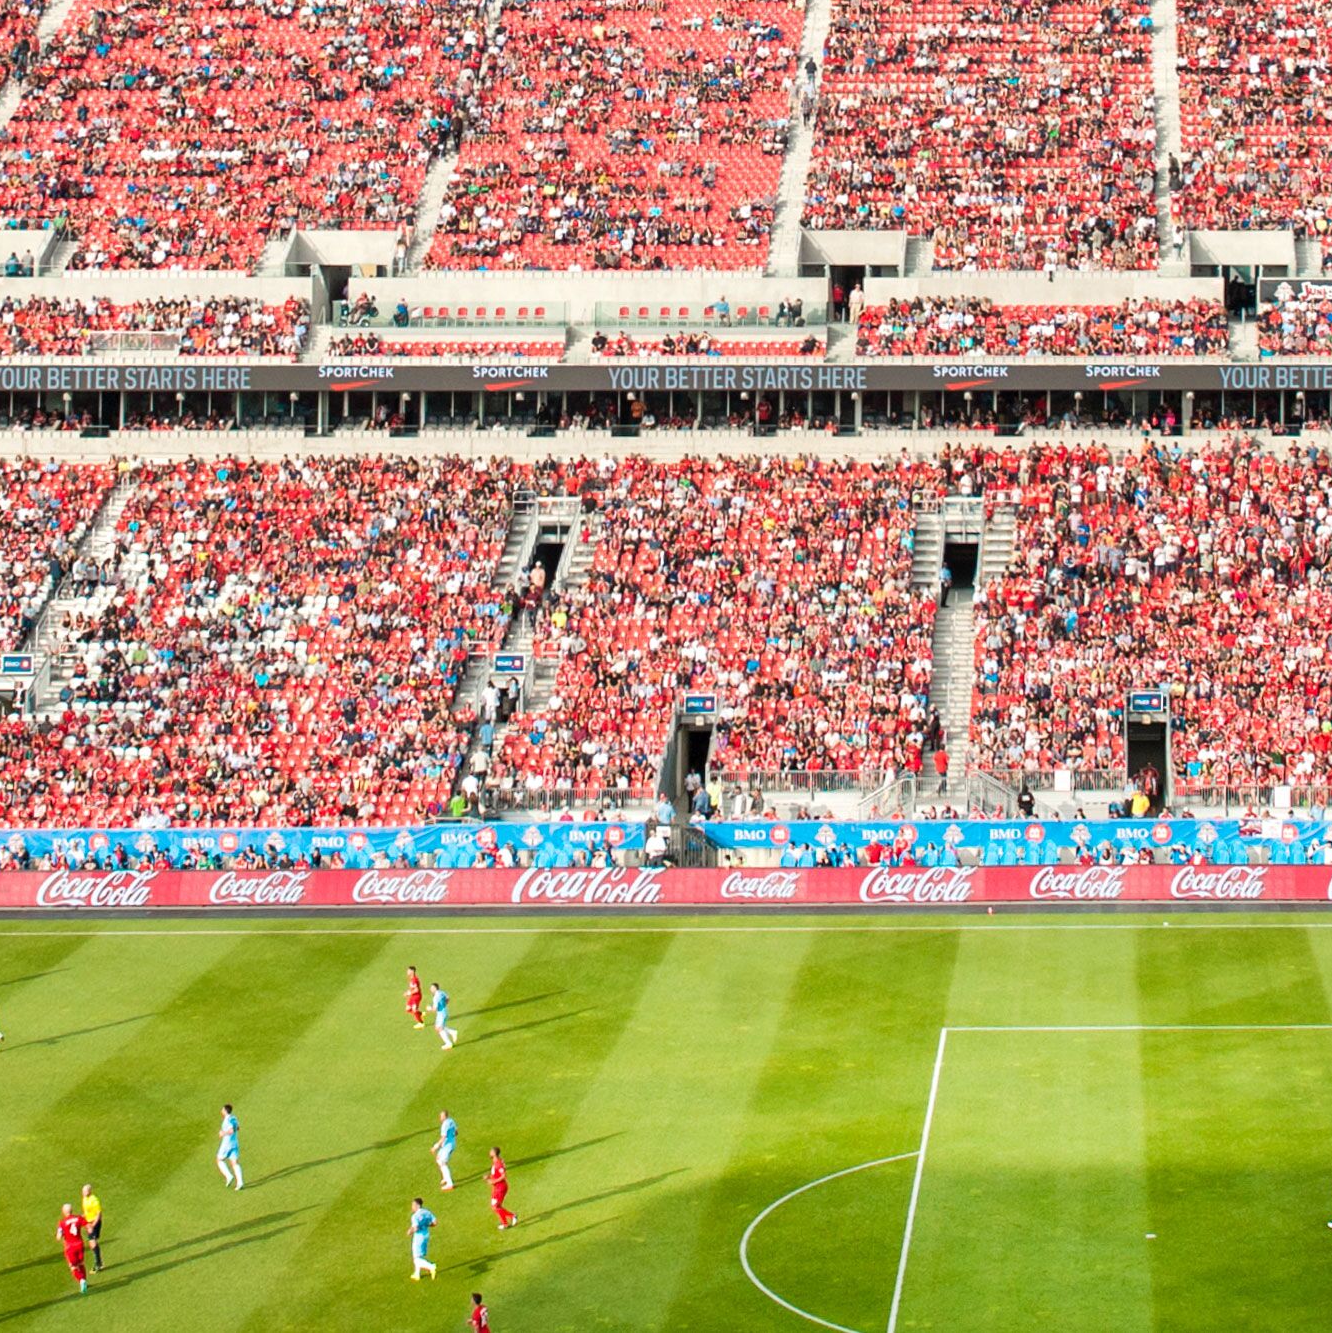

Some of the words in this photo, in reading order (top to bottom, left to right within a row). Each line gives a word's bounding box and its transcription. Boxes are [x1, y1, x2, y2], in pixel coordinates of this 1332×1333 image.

[48, 368, 117, 389] BETTER
[125, 368, 196, 389] STARTS
[202, 368, 251, 389] HERE
[609, 368, 659, 389] YOUR
[665, 368, 736, 389] BETTER
[742, 368, 812, 389] STARTS
[819, 368, 866, 389] HERE
[1219, 367, 1270, 388] YOUR
[182, 838, 215, 848] BMO
[312, 837, 344, 847] BMO
[441, 834, 474, 844] BMO
[569, 830, 601, 842] BMO
[734, 830, 766, 841] BMO
[862, 829, 894, 840] BMO
[989, 828, 1021, 839] BMO
[1117, 828, 1148, 838] BMO
[36, 868, 158, 906] Coca-Cola
[209, 871, 311, 902] Coca-Cola
[353, 870, 453, 902] Coca-Cola
[511, 867, 666, 903] Coca-Cola
[721, 871, 801, 897] Coca-Cola
[860, 867, 977, 902] Coca-Cola
[1029, 867, 1127, 897] Coca-Cola
[1171, 867, 1267, 897] Coca-Cola
